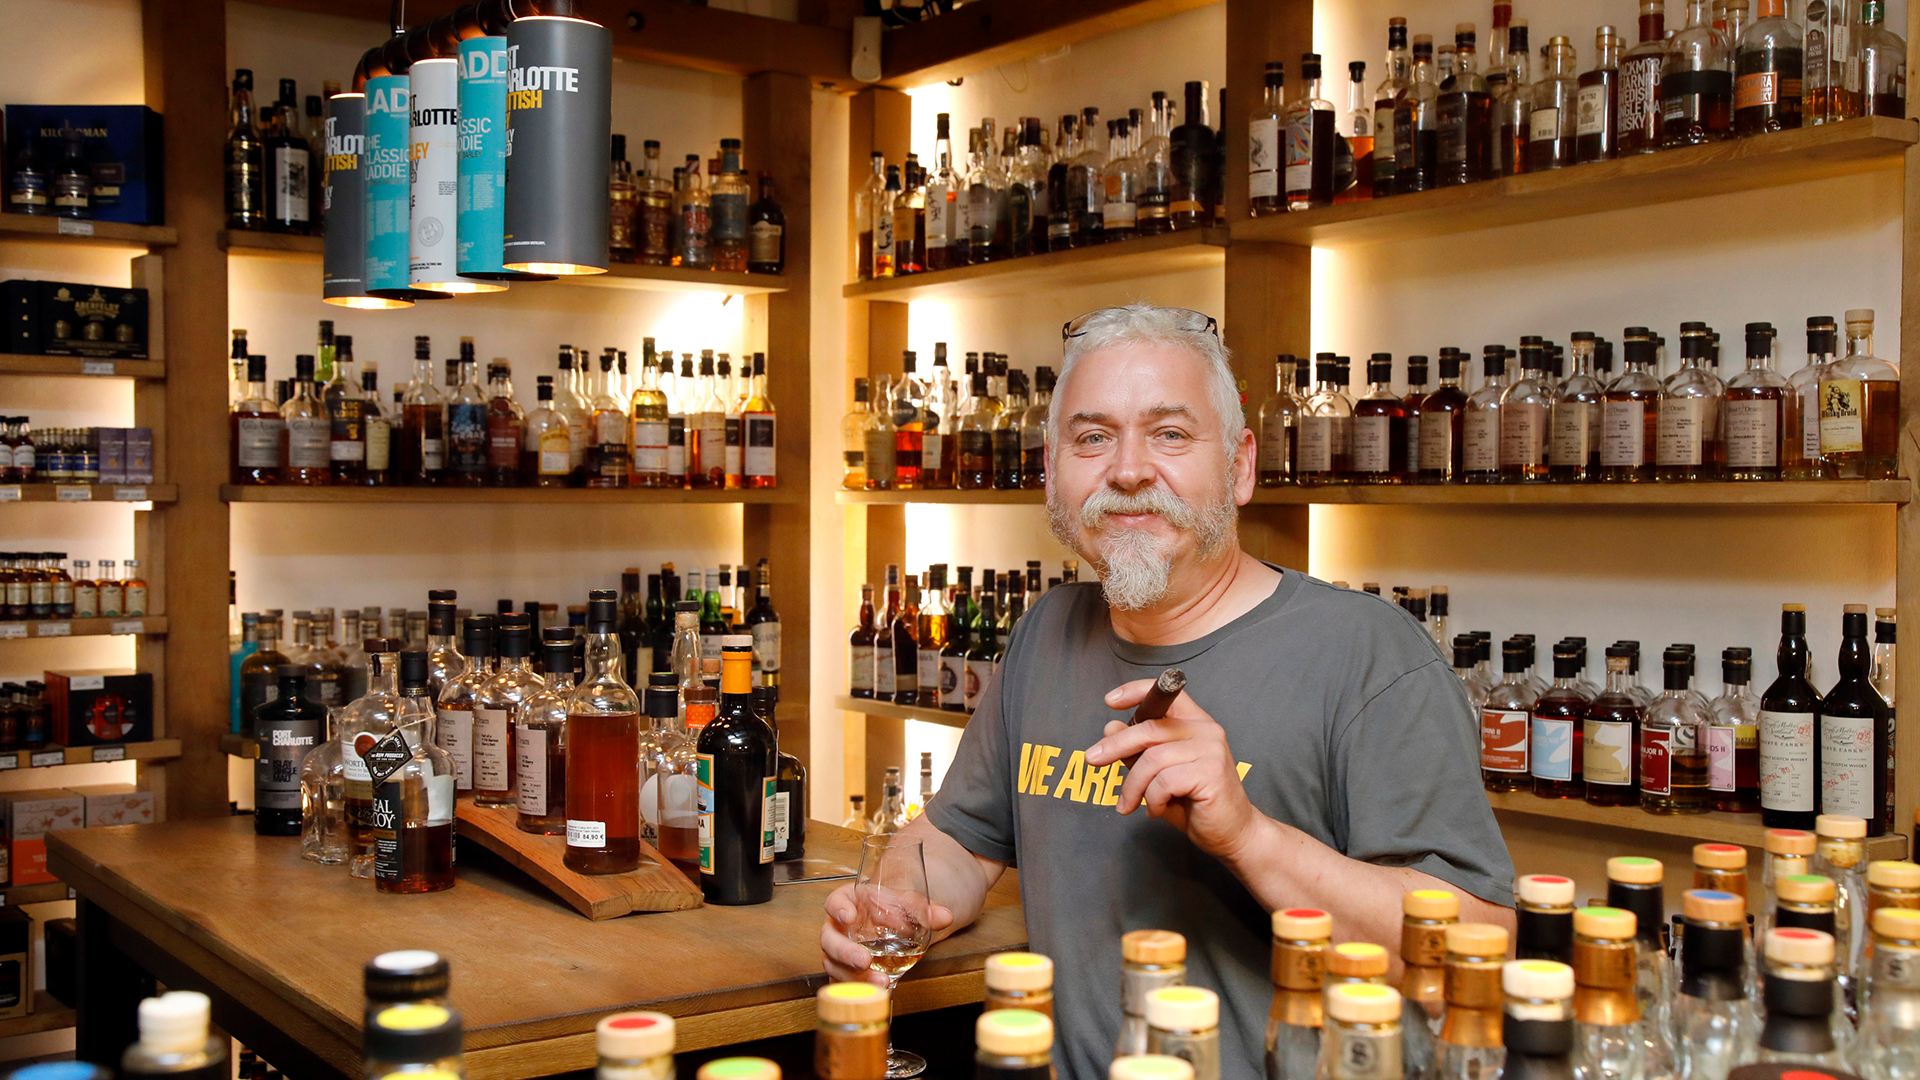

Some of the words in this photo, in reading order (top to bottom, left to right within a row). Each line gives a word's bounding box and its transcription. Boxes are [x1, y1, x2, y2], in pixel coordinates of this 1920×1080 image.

[273, 730, 293, 740] PORT
[272, 736, 314, 746] CHARLOTTE
[1017, 742, 1062, 796] WE
[582, 833, 599, 841] 84,90
